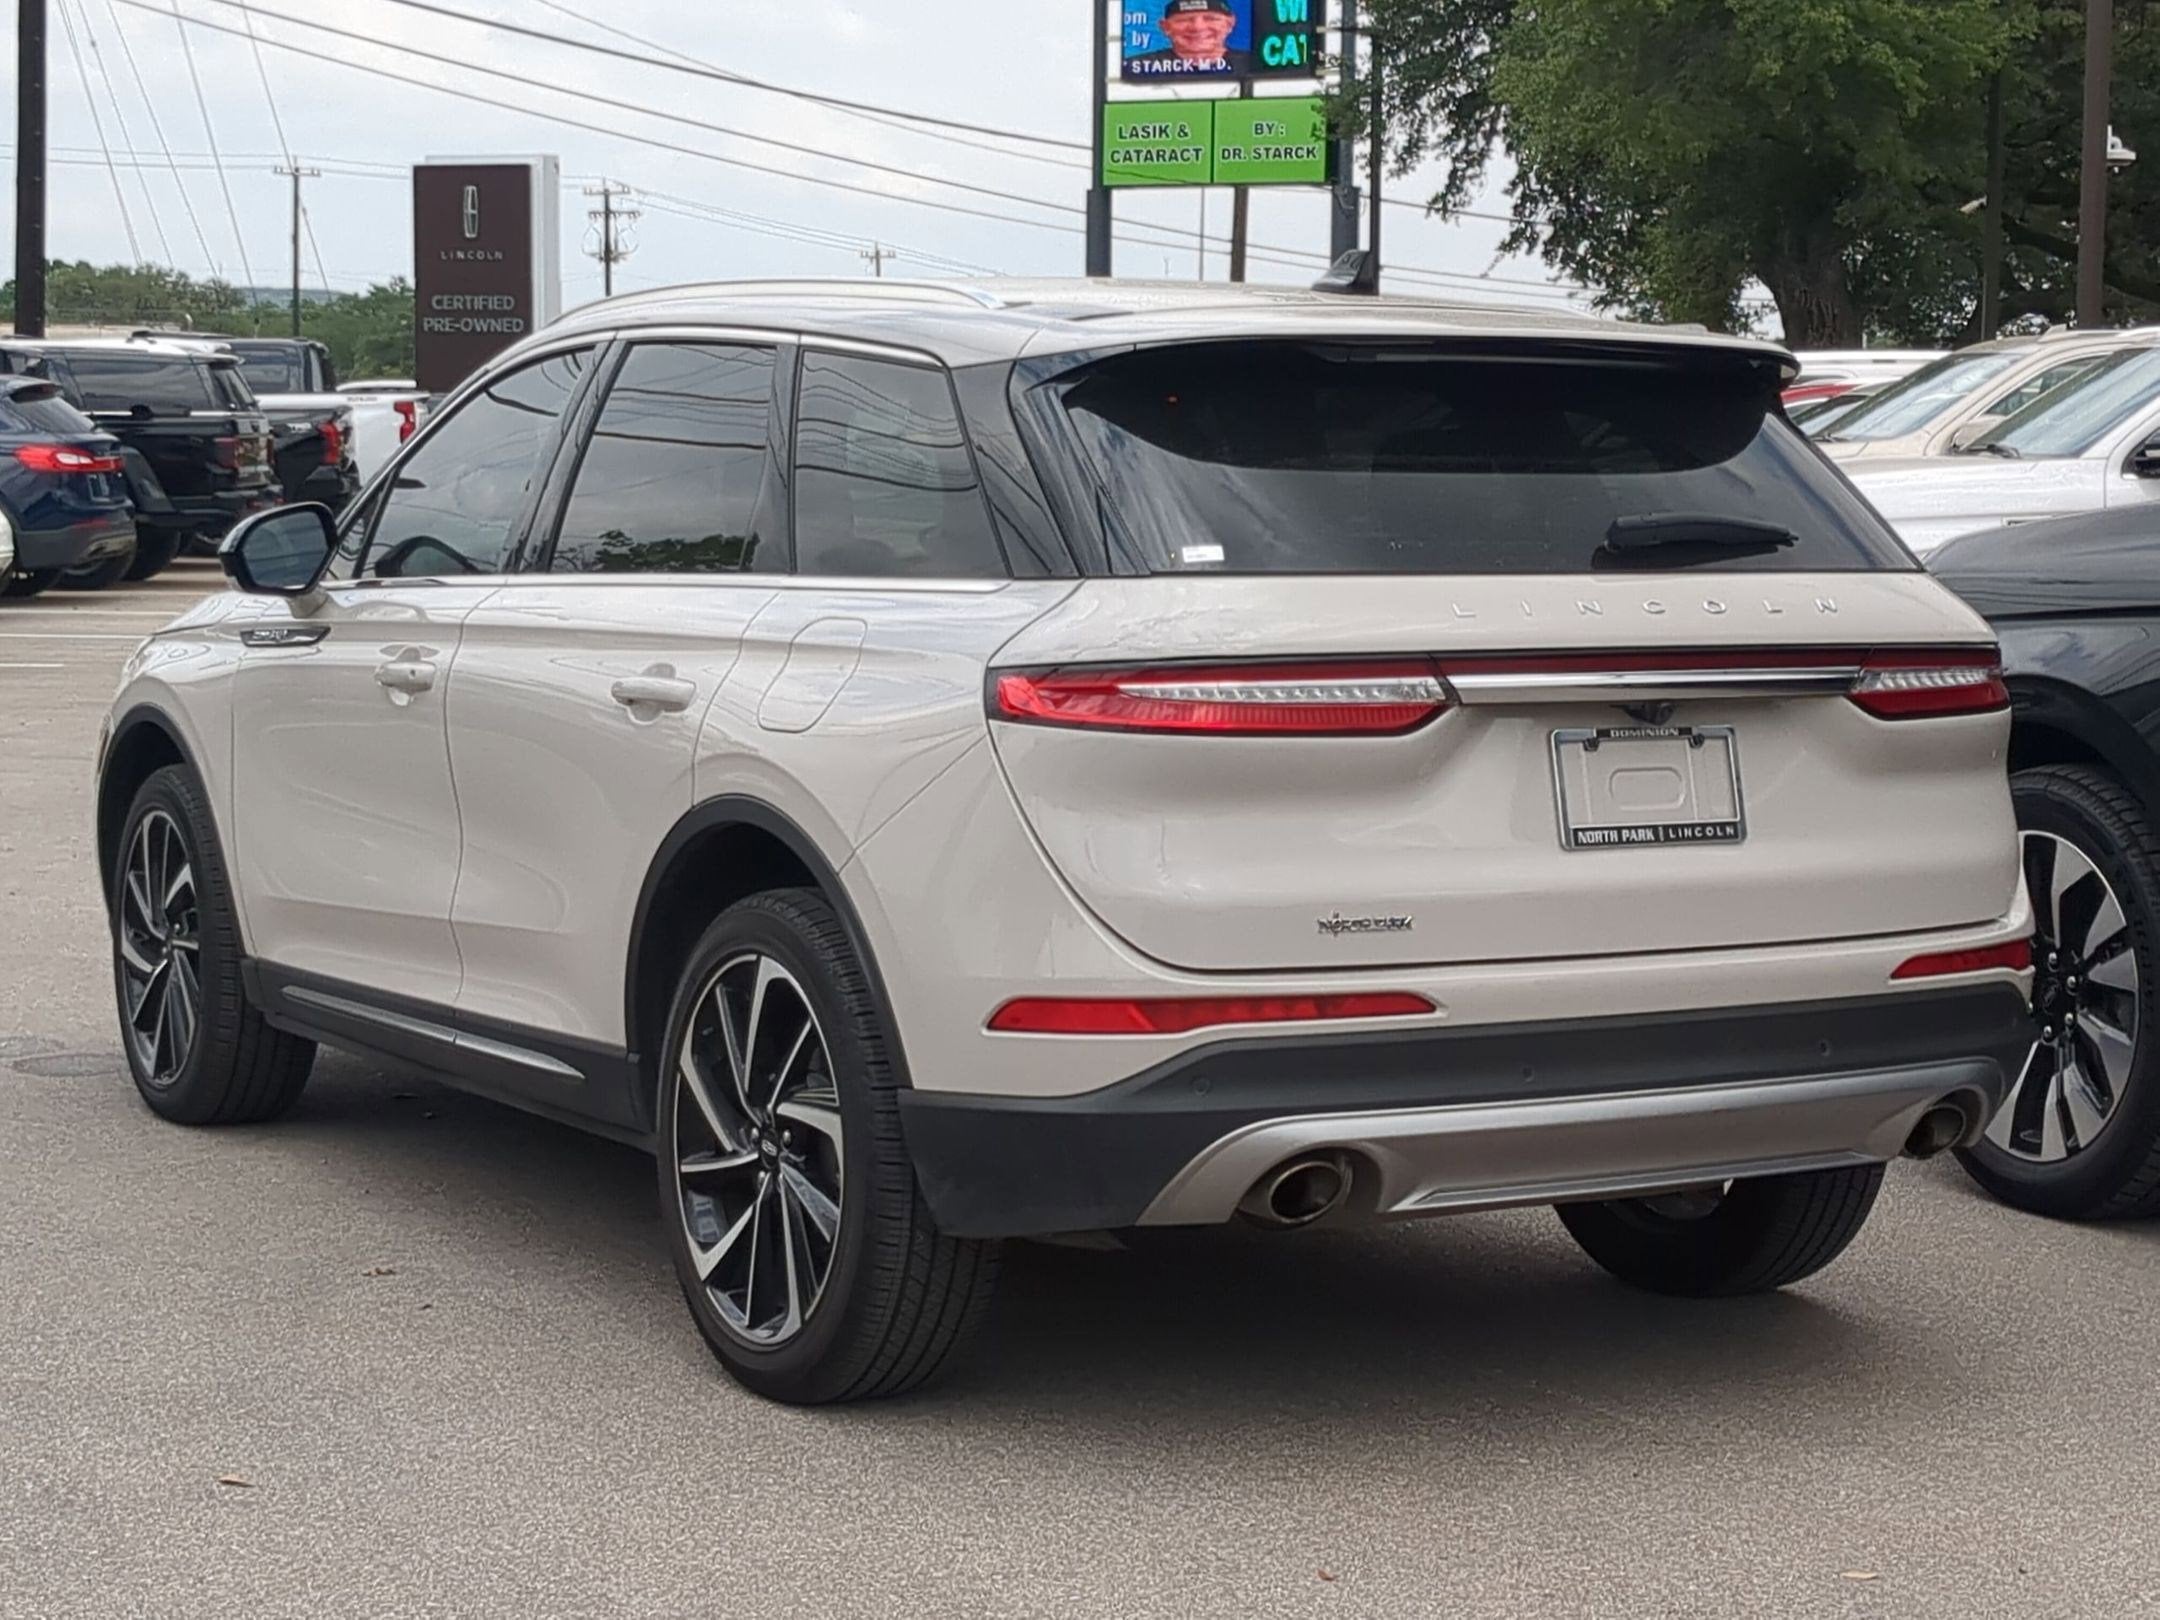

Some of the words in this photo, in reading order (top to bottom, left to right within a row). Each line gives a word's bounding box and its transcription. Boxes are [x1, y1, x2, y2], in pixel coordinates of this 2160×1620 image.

[1132, 31, 1151, 49] by
[1118, 125, 1170, 140] LASIK
[1177, 125, 1189, 138] &
[1110, 148, 1203, 164] CATARACT
[1221, 147, 1247, 161] DR.
[1252, 146, 1318, 160] STARCK
[441, 251, 503, 260] LINCOLN
[432, 296, 515, 310] CERTIFIED
[423, 318, 524, 332] PRE-OWNED
[1452, 597, 1839, 618] LINCOLN
[1610, 728, 1679, 737] DOMINION
[1577, 829, 1618, 844] NORTH
[1622, 828, 1654, 842] PARK
[1668, 826, 1735, 839] LINCOLN
